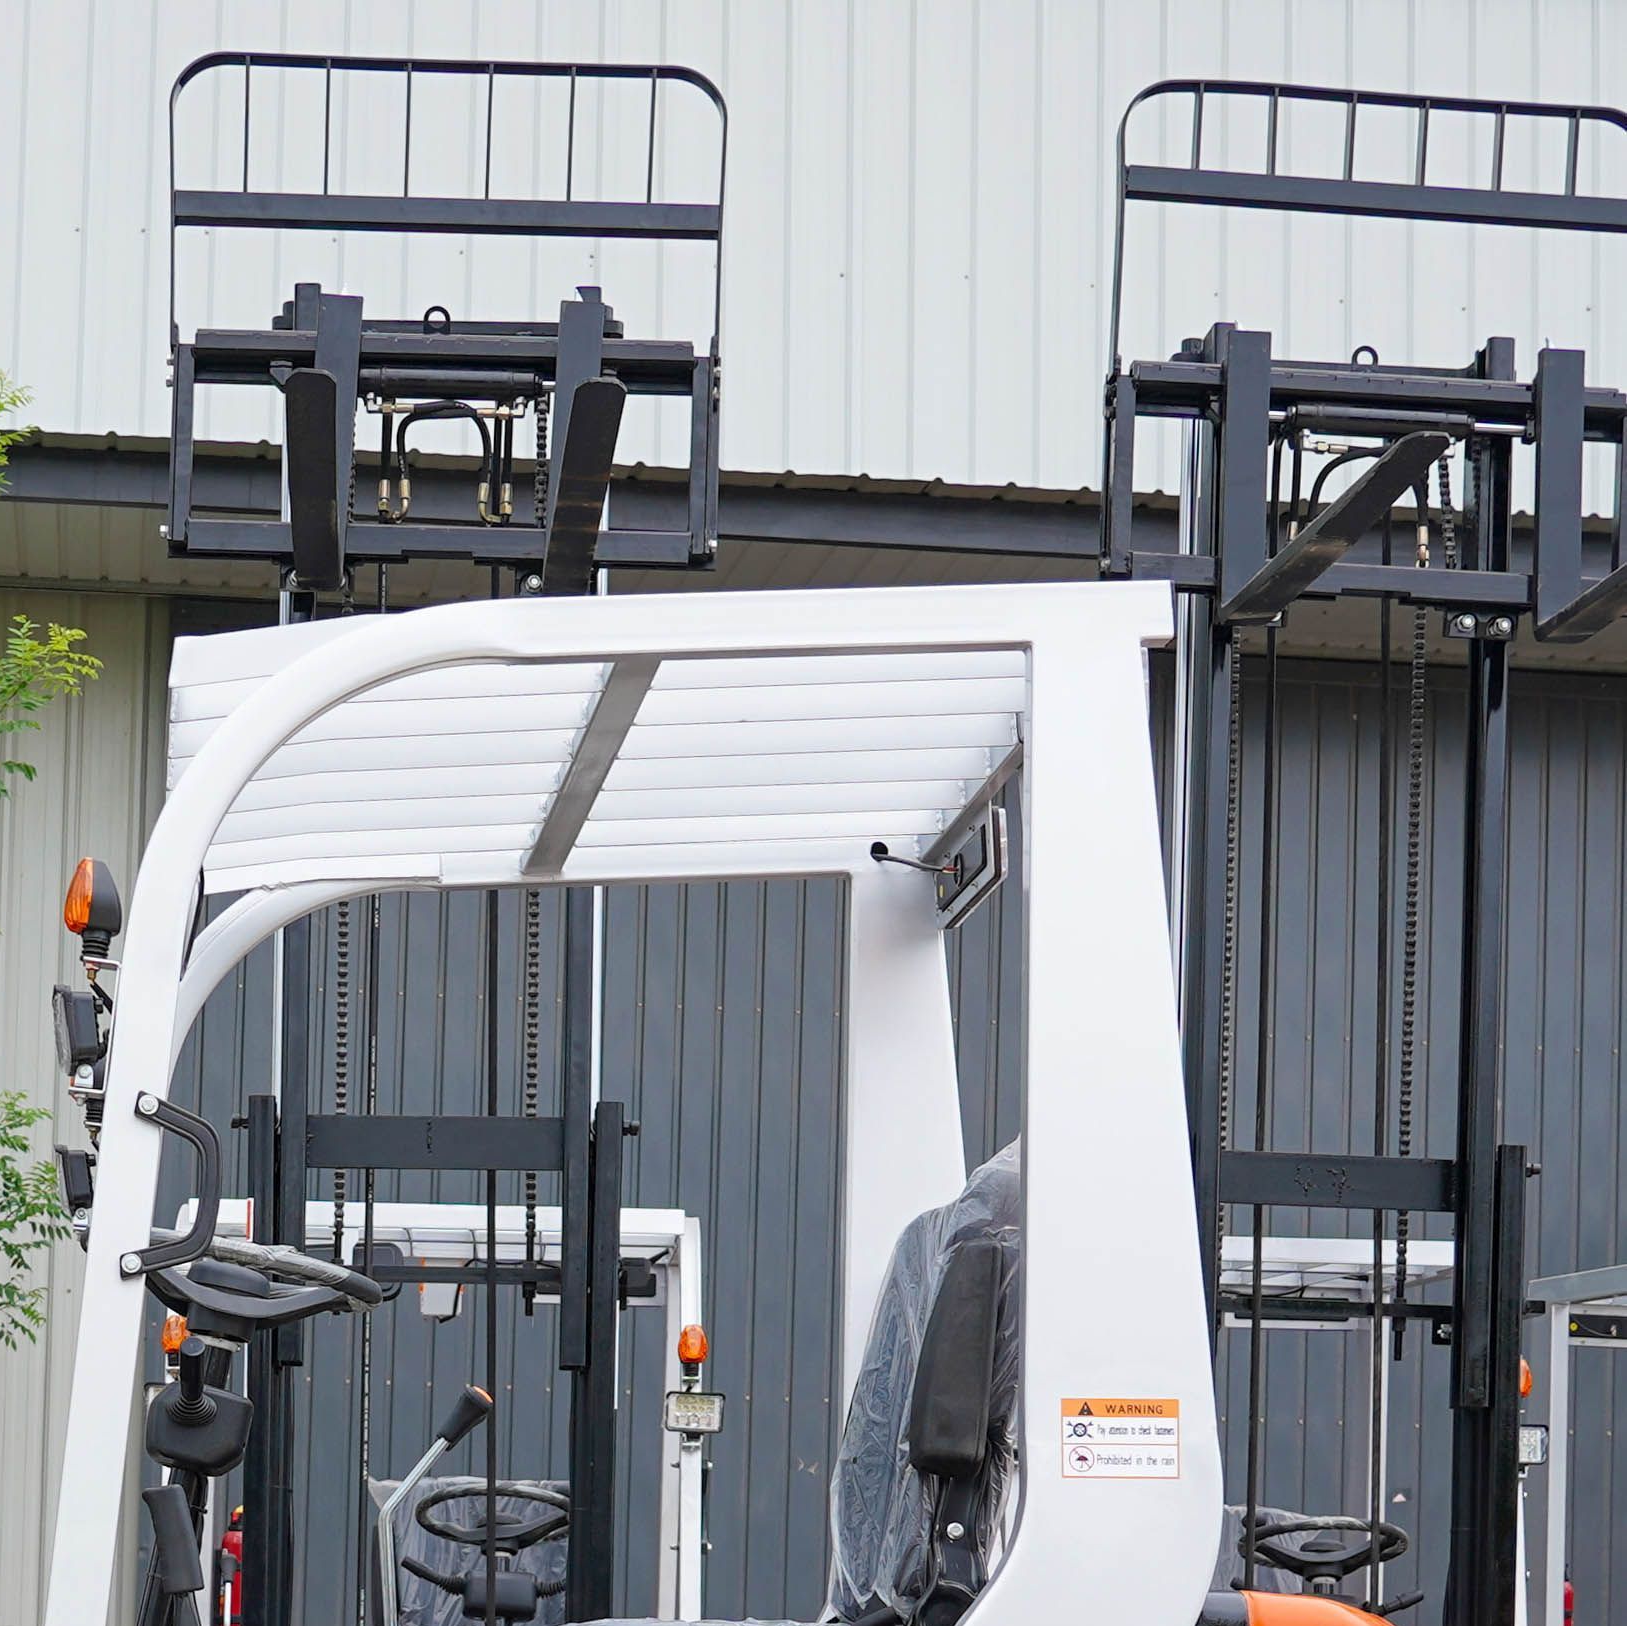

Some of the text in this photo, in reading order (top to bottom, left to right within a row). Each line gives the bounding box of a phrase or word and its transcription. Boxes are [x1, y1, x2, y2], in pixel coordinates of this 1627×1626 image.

[1105, 1404, 1163, 1415] WARNING
[1097, 1454, 1175, 1466] Prohibited in the rain
